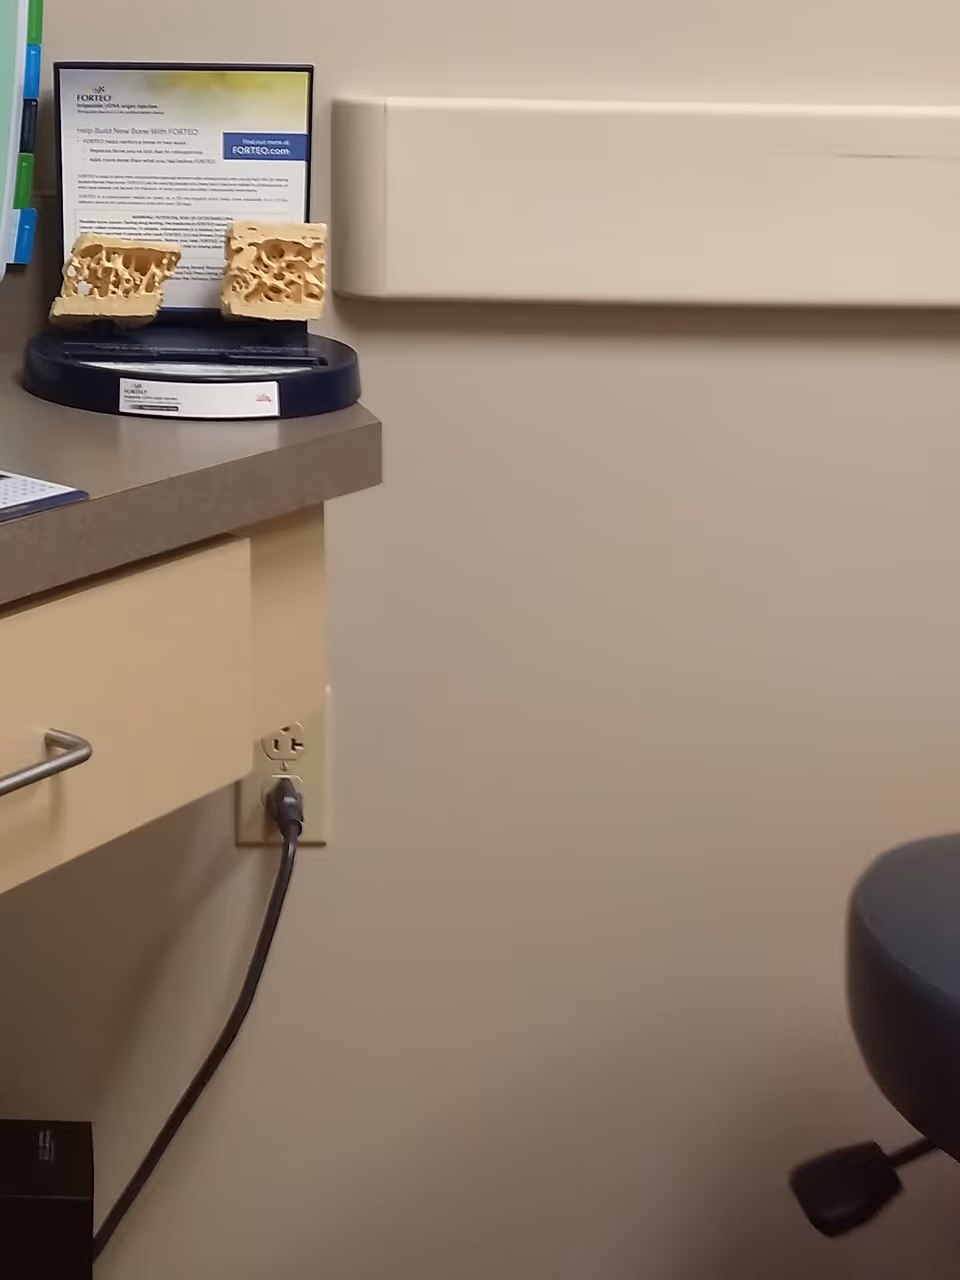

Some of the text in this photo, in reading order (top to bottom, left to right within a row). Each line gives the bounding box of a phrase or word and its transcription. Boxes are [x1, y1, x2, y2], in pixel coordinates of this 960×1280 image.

[76, 94, 112, 102] FORTEO
[130, 128, 149, 136] Bone
[231, 145, 290, 155] FORTEO.com
